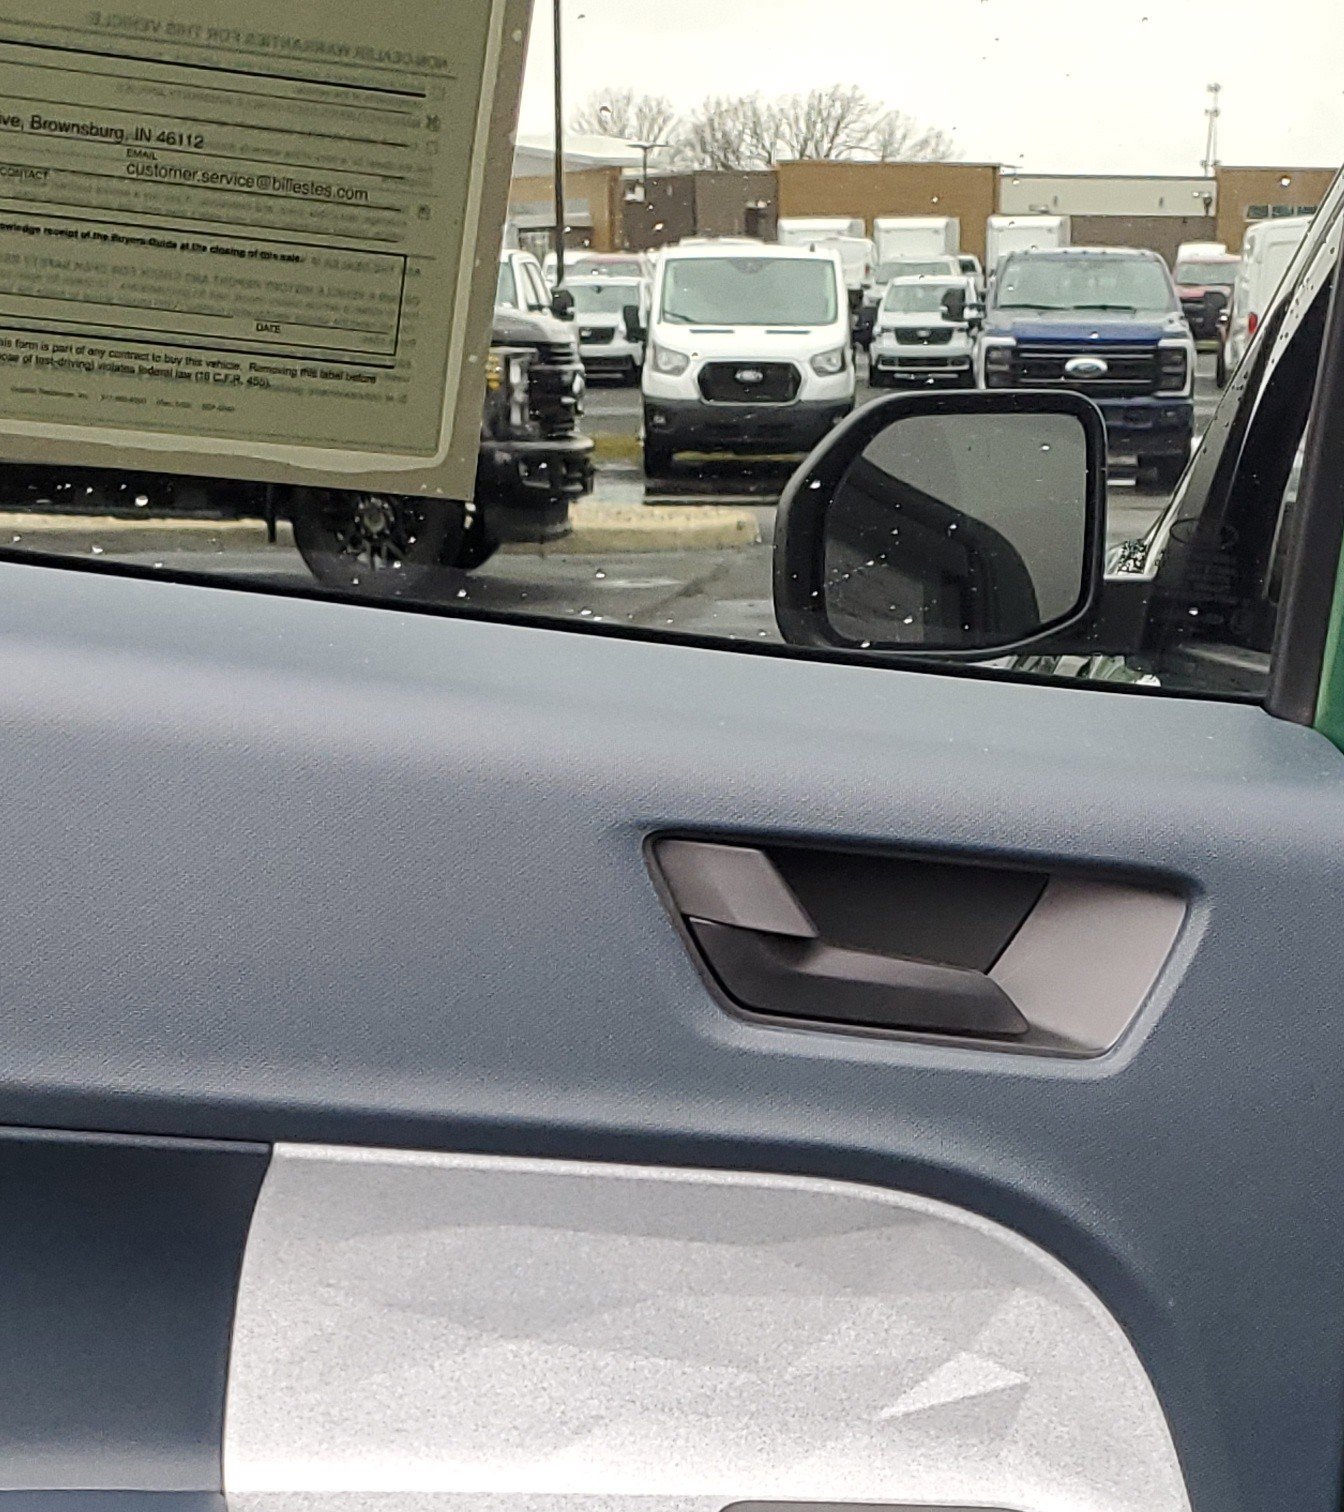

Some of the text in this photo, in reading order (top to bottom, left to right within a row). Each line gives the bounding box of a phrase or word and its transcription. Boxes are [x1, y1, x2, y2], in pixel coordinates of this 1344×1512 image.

[134, 126, 152, 142] IN
[156, 130, 204, 150] 46112
[126, 148, 158, 161] EMAIL
[256, 322, 281, 334] DATE
[14, 338, 39, 351] form
[52, 343, 73, 358] part
[75, 344, 86, 356] of
[87, 347, 105, 361] any
[109, 349, 149, 363] contract
[164, 354, 183, 368] buy
[185, 355, 203, 367] this
[249, 362, 298, 379] Removing
[22, 352, 33, 365] of
[175, 368, 193, 381] law
